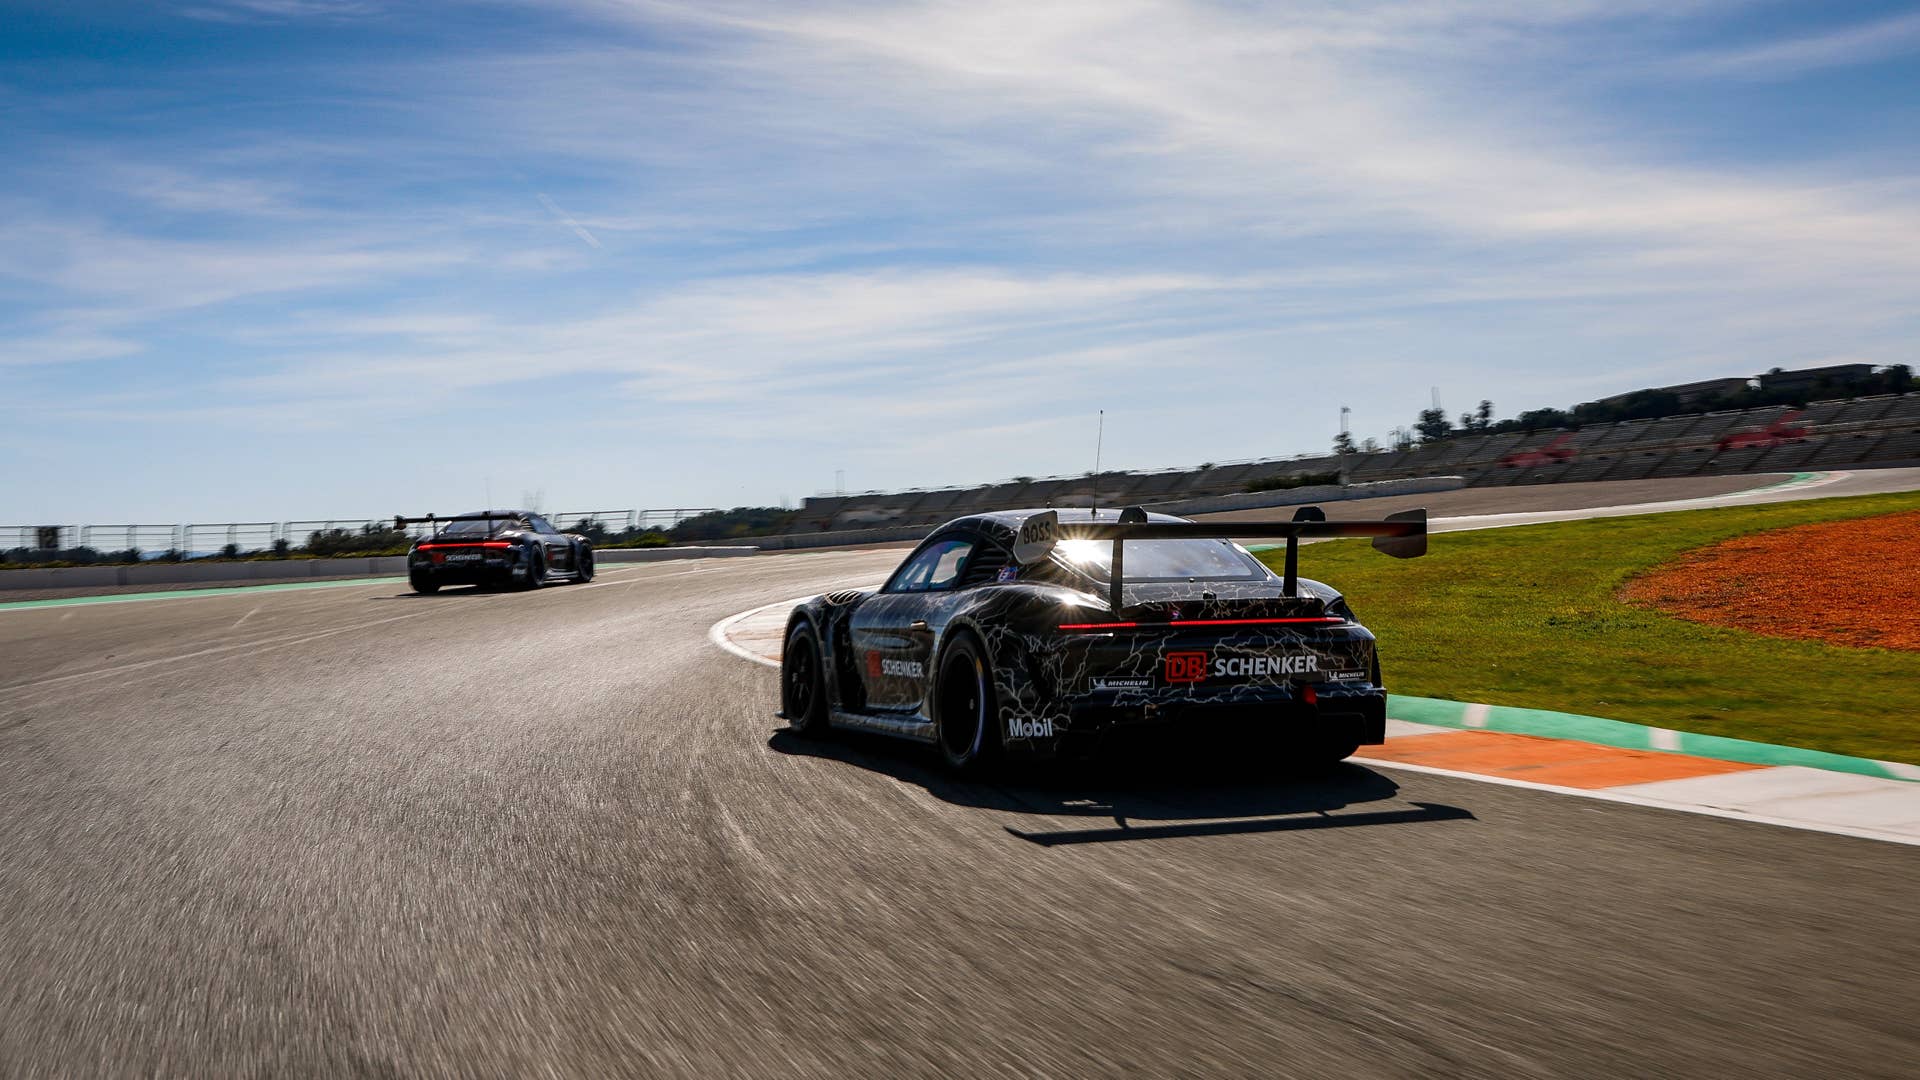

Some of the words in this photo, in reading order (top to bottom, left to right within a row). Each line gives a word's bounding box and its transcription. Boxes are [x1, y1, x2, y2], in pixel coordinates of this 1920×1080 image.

[1023, 521, 1050, 544] BOSS
[881, 658, 925, 678] SCHENKER
[1170, 656, 1202, 678] DB
[1214, 656, 1318, 677] SCHENKER
[1107, 679, 1150, 687] MICHELIN
[1008, 717, 1054, 737] Mobil
